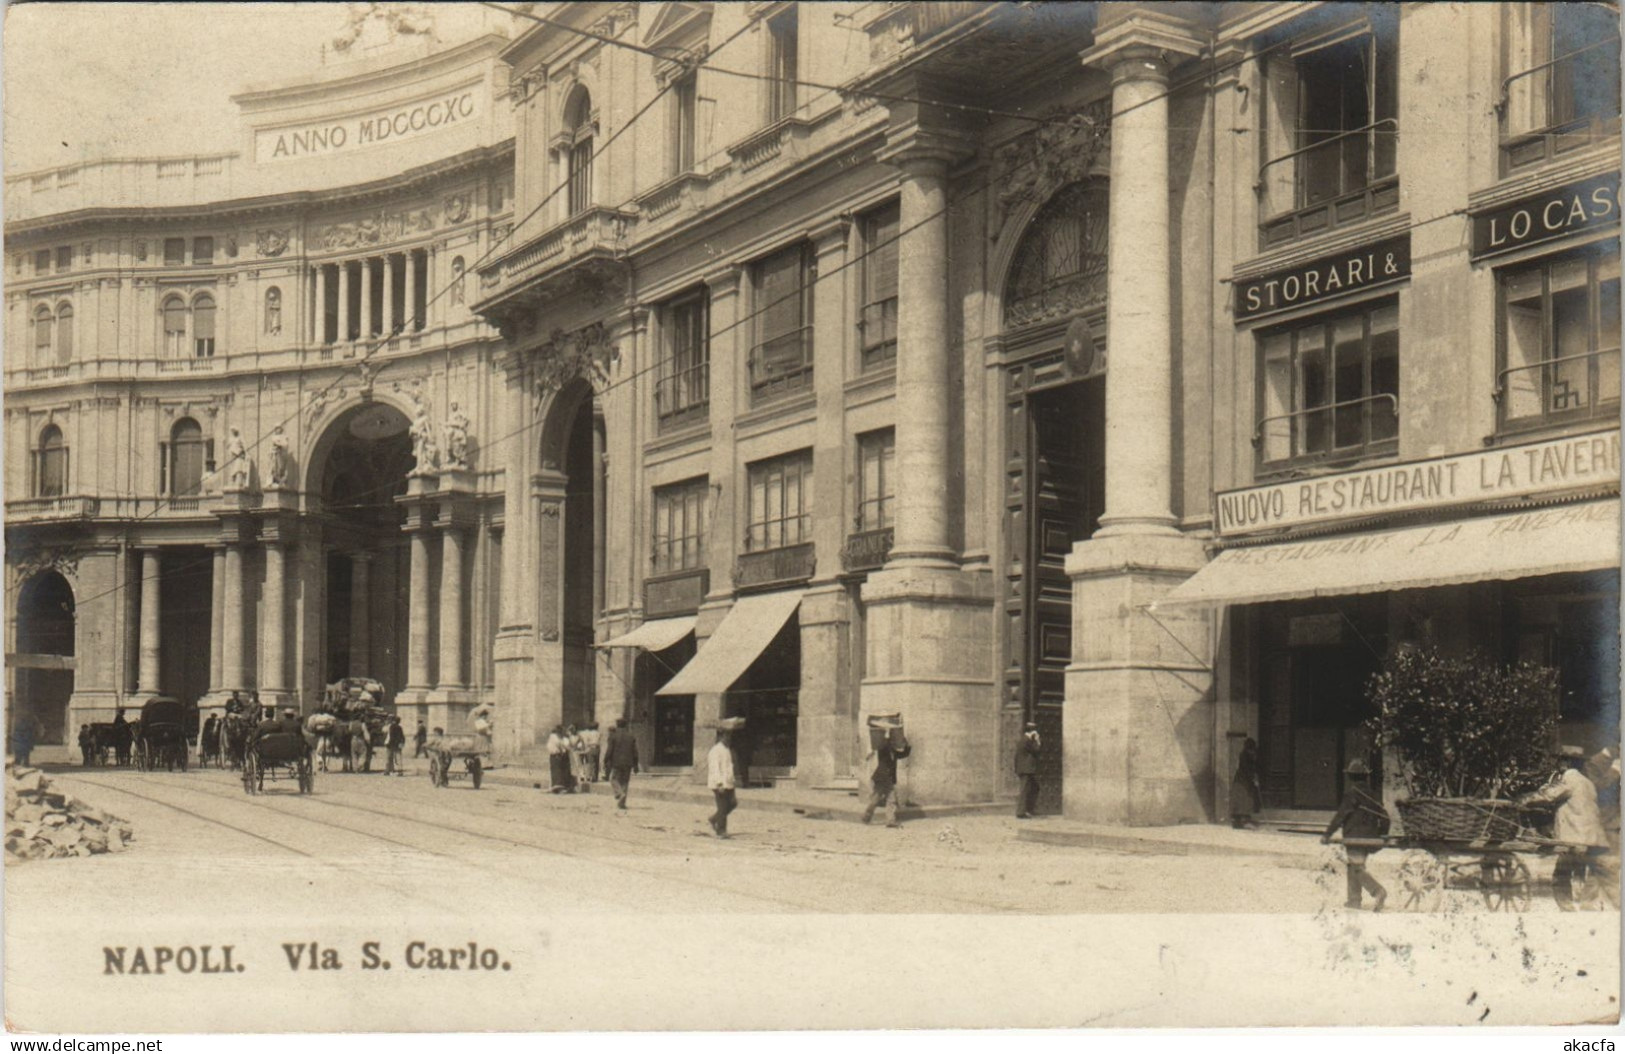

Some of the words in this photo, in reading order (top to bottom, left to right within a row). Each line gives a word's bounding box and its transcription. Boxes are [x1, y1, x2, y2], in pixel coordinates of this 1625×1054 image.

[271, 125, 347, 157] ANNO
[357, 92, 474, 144] MDCCCXC
[1489, 209, 1532, 246] LO
[1542, 186, 1622, 230] CAS
[1245, 256, 1375, 312] STORARI
[1384, 252, 1399, 275] &
[1220, 487, 1284, 528] NUOVO
[1299, 461, 1460, 515] RESTAURANT
[1479, 450, 1515, 490] LA
[1225, 534, 1391, 566] RESTAURANT
